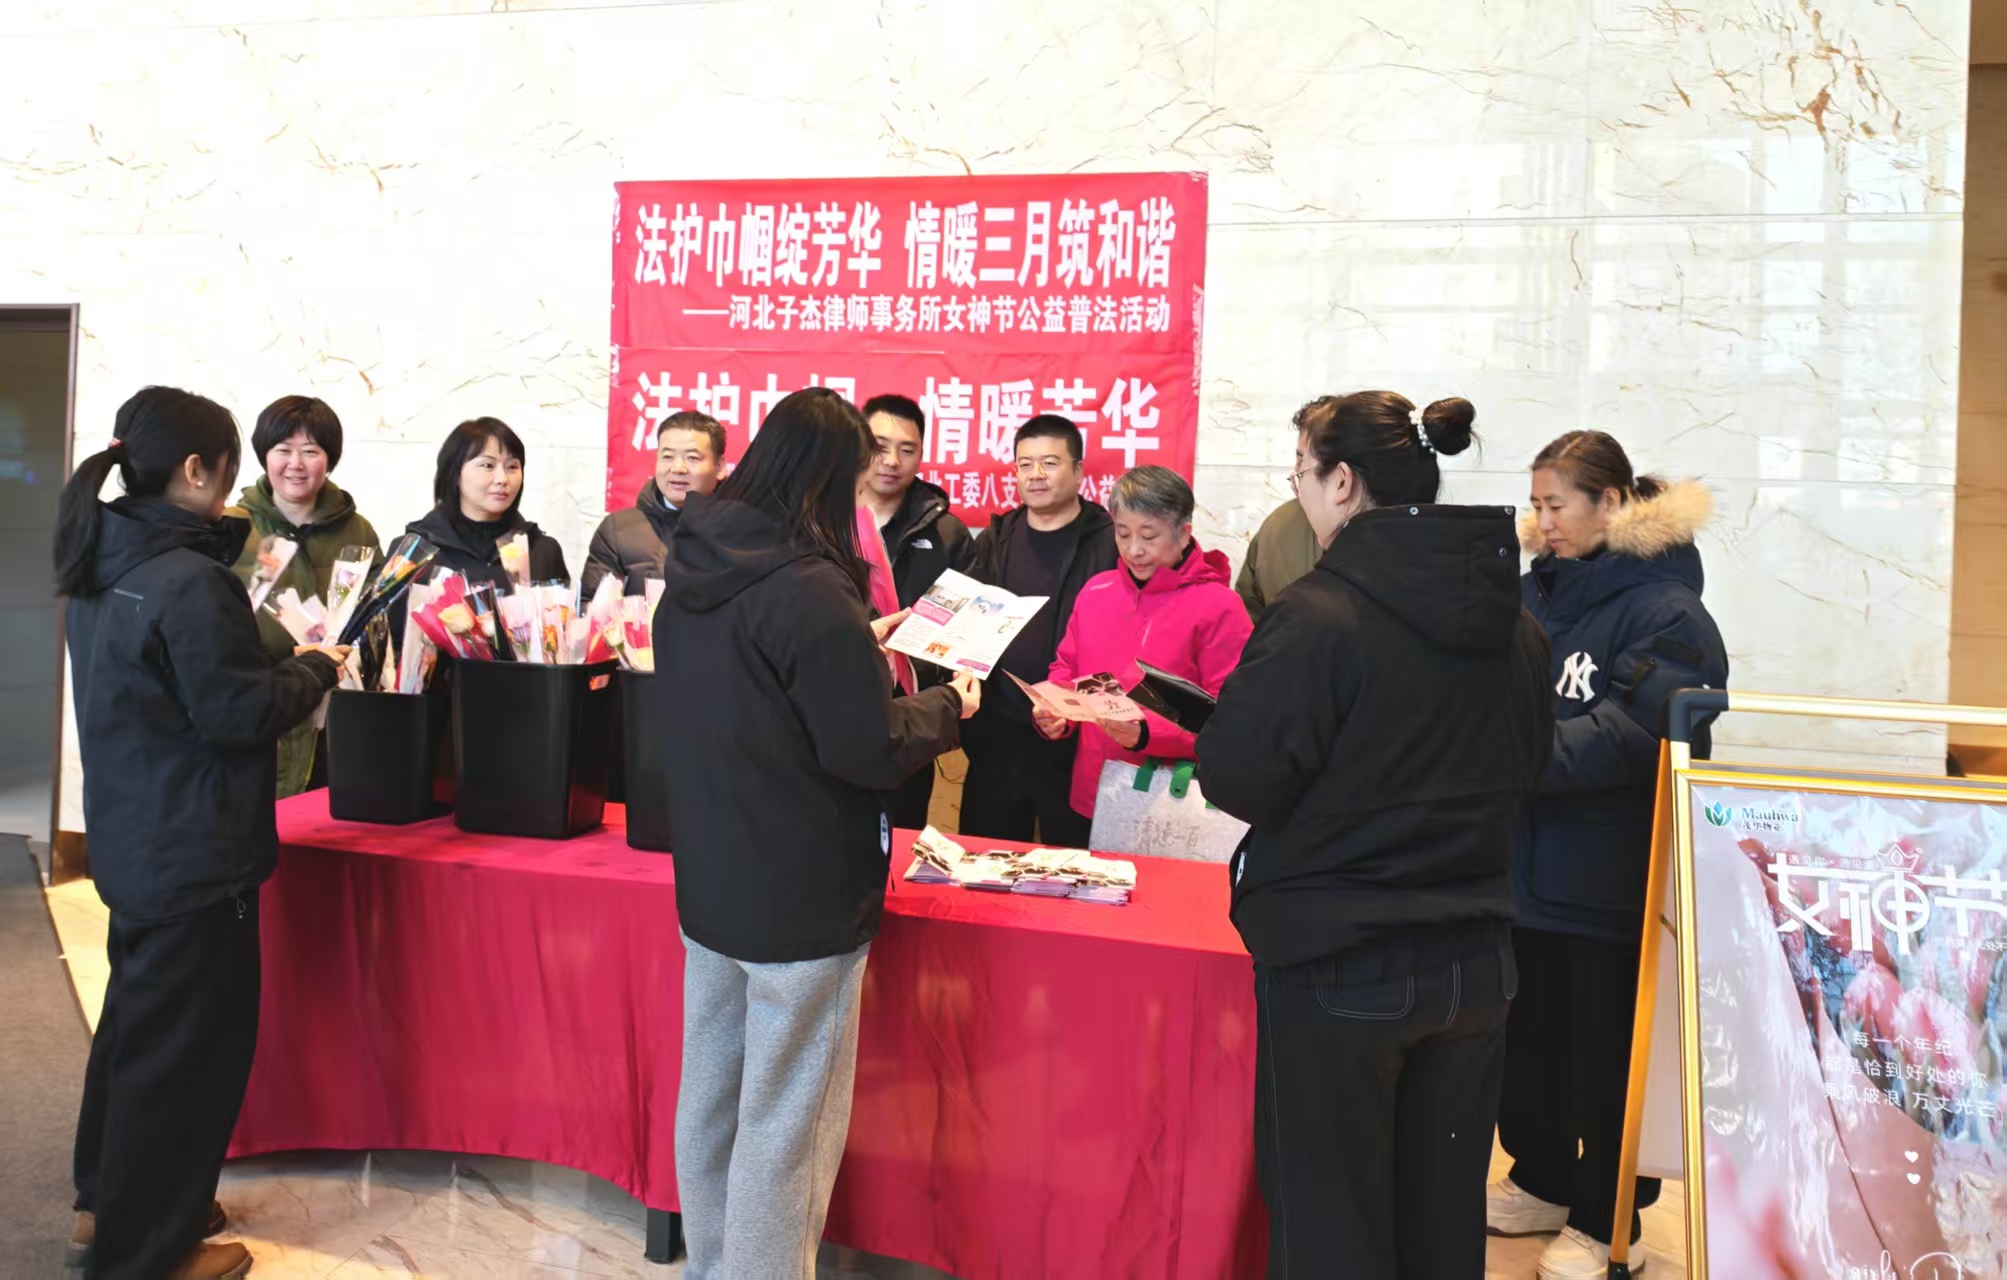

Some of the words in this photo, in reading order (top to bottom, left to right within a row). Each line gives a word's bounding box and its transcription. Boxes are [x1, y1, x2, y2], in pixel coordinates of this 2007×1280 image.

[634, 200, 882, 289] 法护巾帼绽芳华
[903, 196, 1177, 289] 情暖三月筑和谐
[1555, 651, 1599, 703] NY
[1852, 1031, 1954, 1057] 每一个年纪
[1823, 1056, 1988, 1090] 都是恰到好处的你
[1911, 1091, 1997, 1119] 万丈光芒
